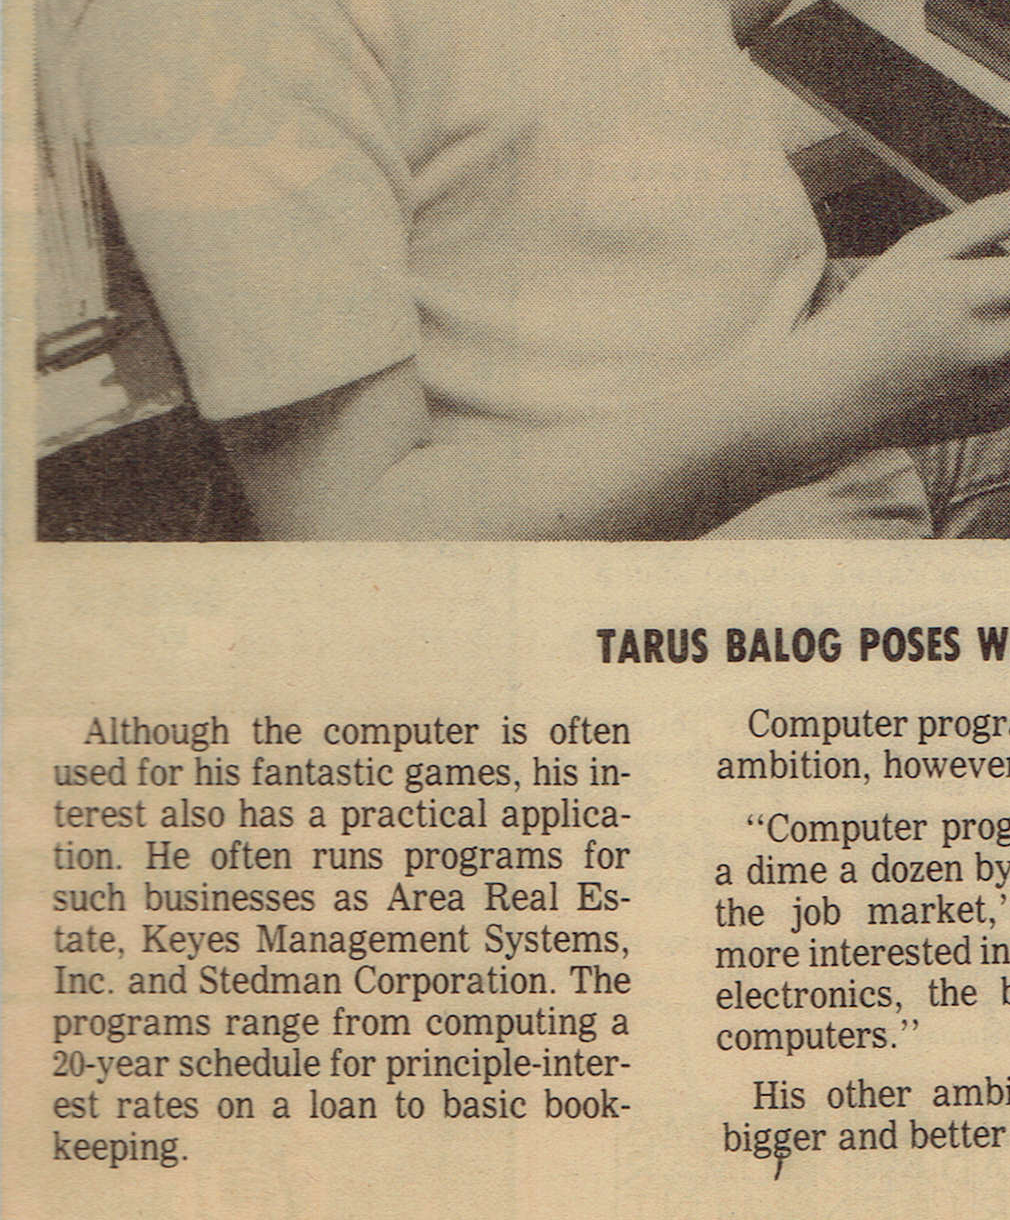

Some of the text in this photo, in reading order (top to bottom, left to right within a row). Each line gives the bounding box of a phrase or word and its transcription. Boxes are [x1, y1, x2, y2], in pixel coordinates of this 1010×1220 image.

[595, 627, 710, 665] TARUS
[725, 626, 843, 664] BALOG
[859, 625, 962, 663] POSES
[83, 714, 631, 753] Although the computer is often
[747, 708, 909, 746] Computer
[52, 755, 631, 794] used for his fantastic games, his in-
[716, 748, 871, 786] ambition,
[53, 797, 632, 837] terest also has a practical applica-
[52, 838, 631, 878] tion. He often runs programs for
[714, 863, 734, 887] a
[746, 854, 828, 886] dime
[839, 861, 859, 884] a
[870, 852, 964, 884] dozen
[52, 880, 631, 913] such businesses as Area Real Es-
[53, 922, 629, 962] tate, Keyes Management Systems,
[715, 945, 800, 969] more
[808, 934, 973, 968] interested
[53, 963, 632, 1003] Inc. and Stedman Corporation. The
[715, 978, 903, 1015] electronics,
[927, 976, 978, 1008] the
[52, 1005, 630, 1045] programs range from computing a
[52, 1046, 631, 1086] 20-year schedule for principle-inter-
[52, 1087, 632, 1120] est rates on a loan to basic book-
[752, 1079, 806, 1110] His
[826, 1077, 913, 1110] other
[52, 1130, 189, 1170] keeping.
[722, 1121, 829, 1159] bigger
[838, 1118, 899, 1152] and
[908, 1118, 1007, 1150] better
